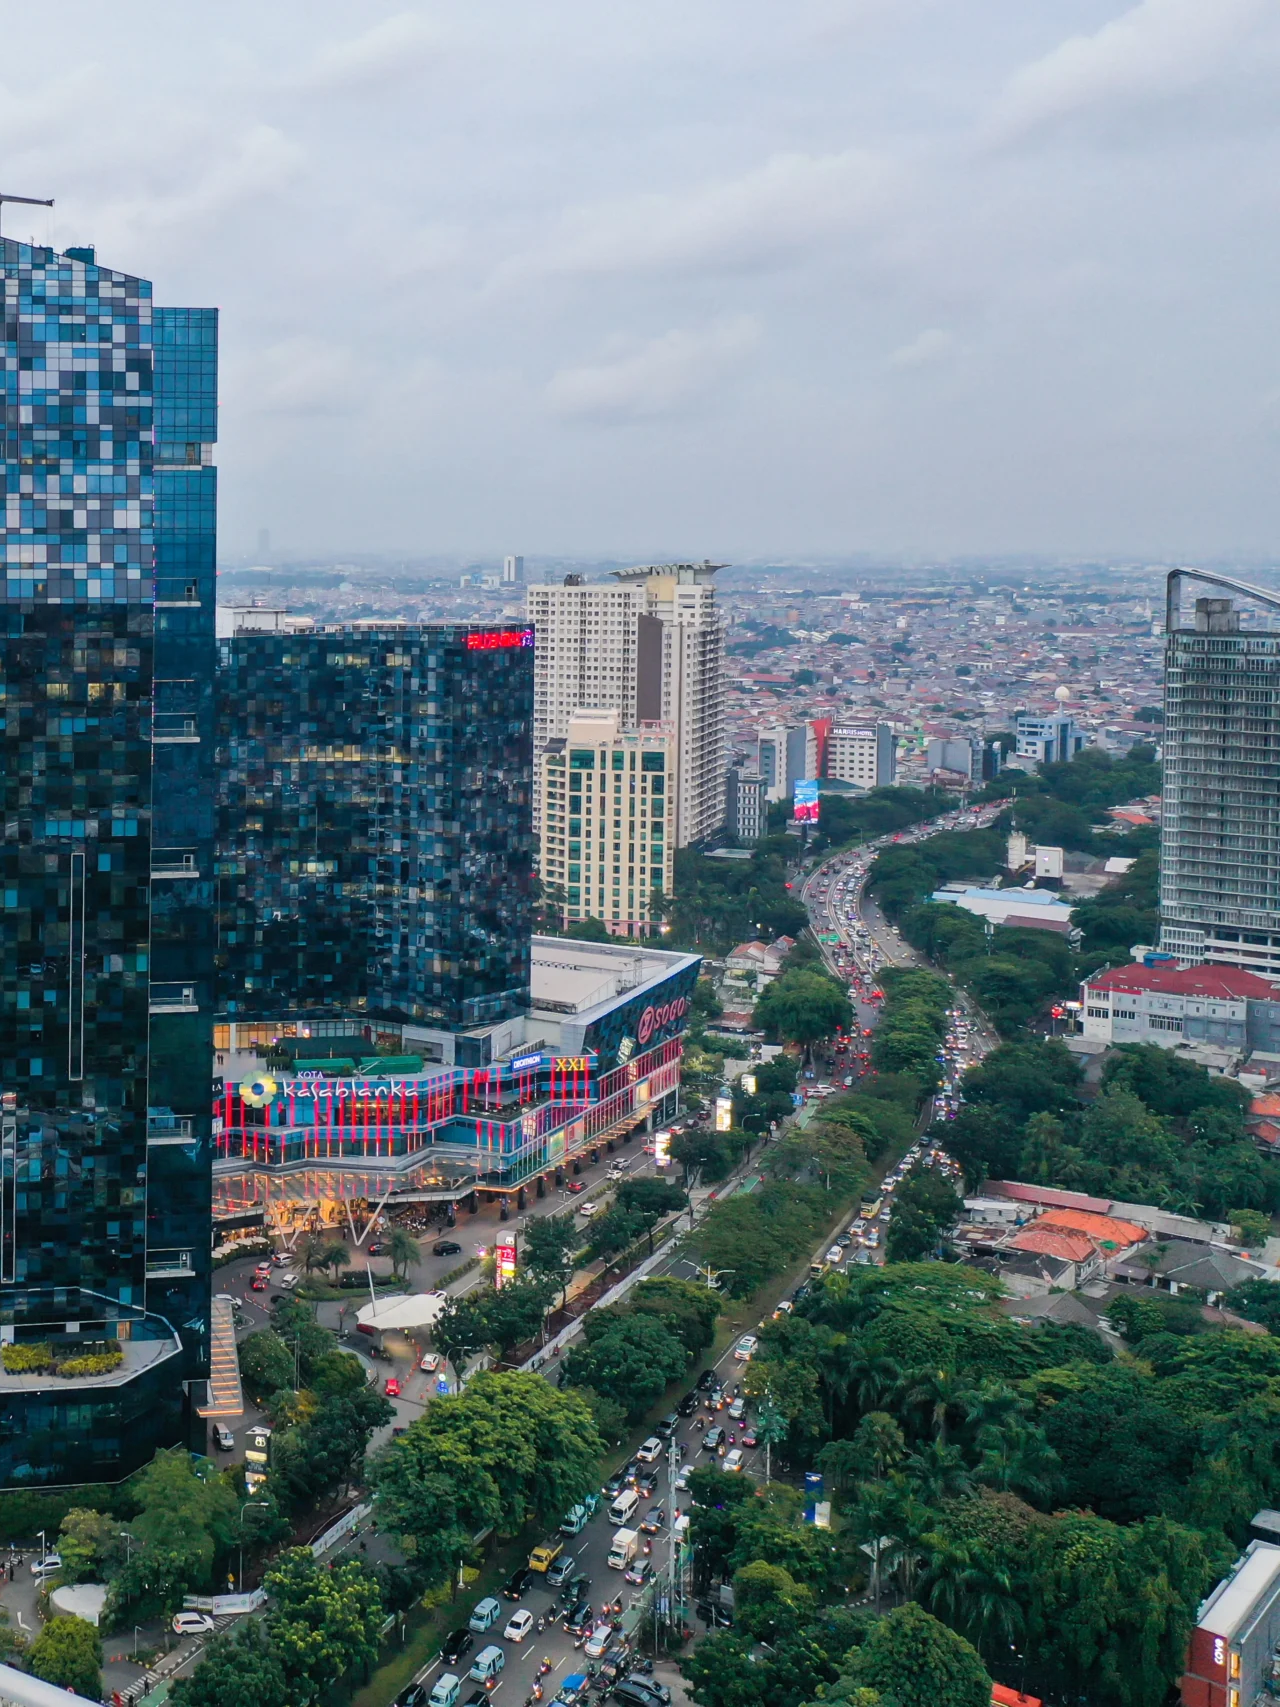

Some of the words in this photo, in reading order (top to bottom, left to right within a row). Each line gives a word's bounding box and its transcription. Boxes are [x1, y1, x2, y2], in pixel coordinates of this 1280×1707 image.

[654, 996, 685, 1029] SOGO
[556, 1057, 586, 1072] XXI
[297, 1070, 324, 1079] KOTA
[255, 1435, 267, 1448] 88
[1214, 1638, 1224, 1665] cove
